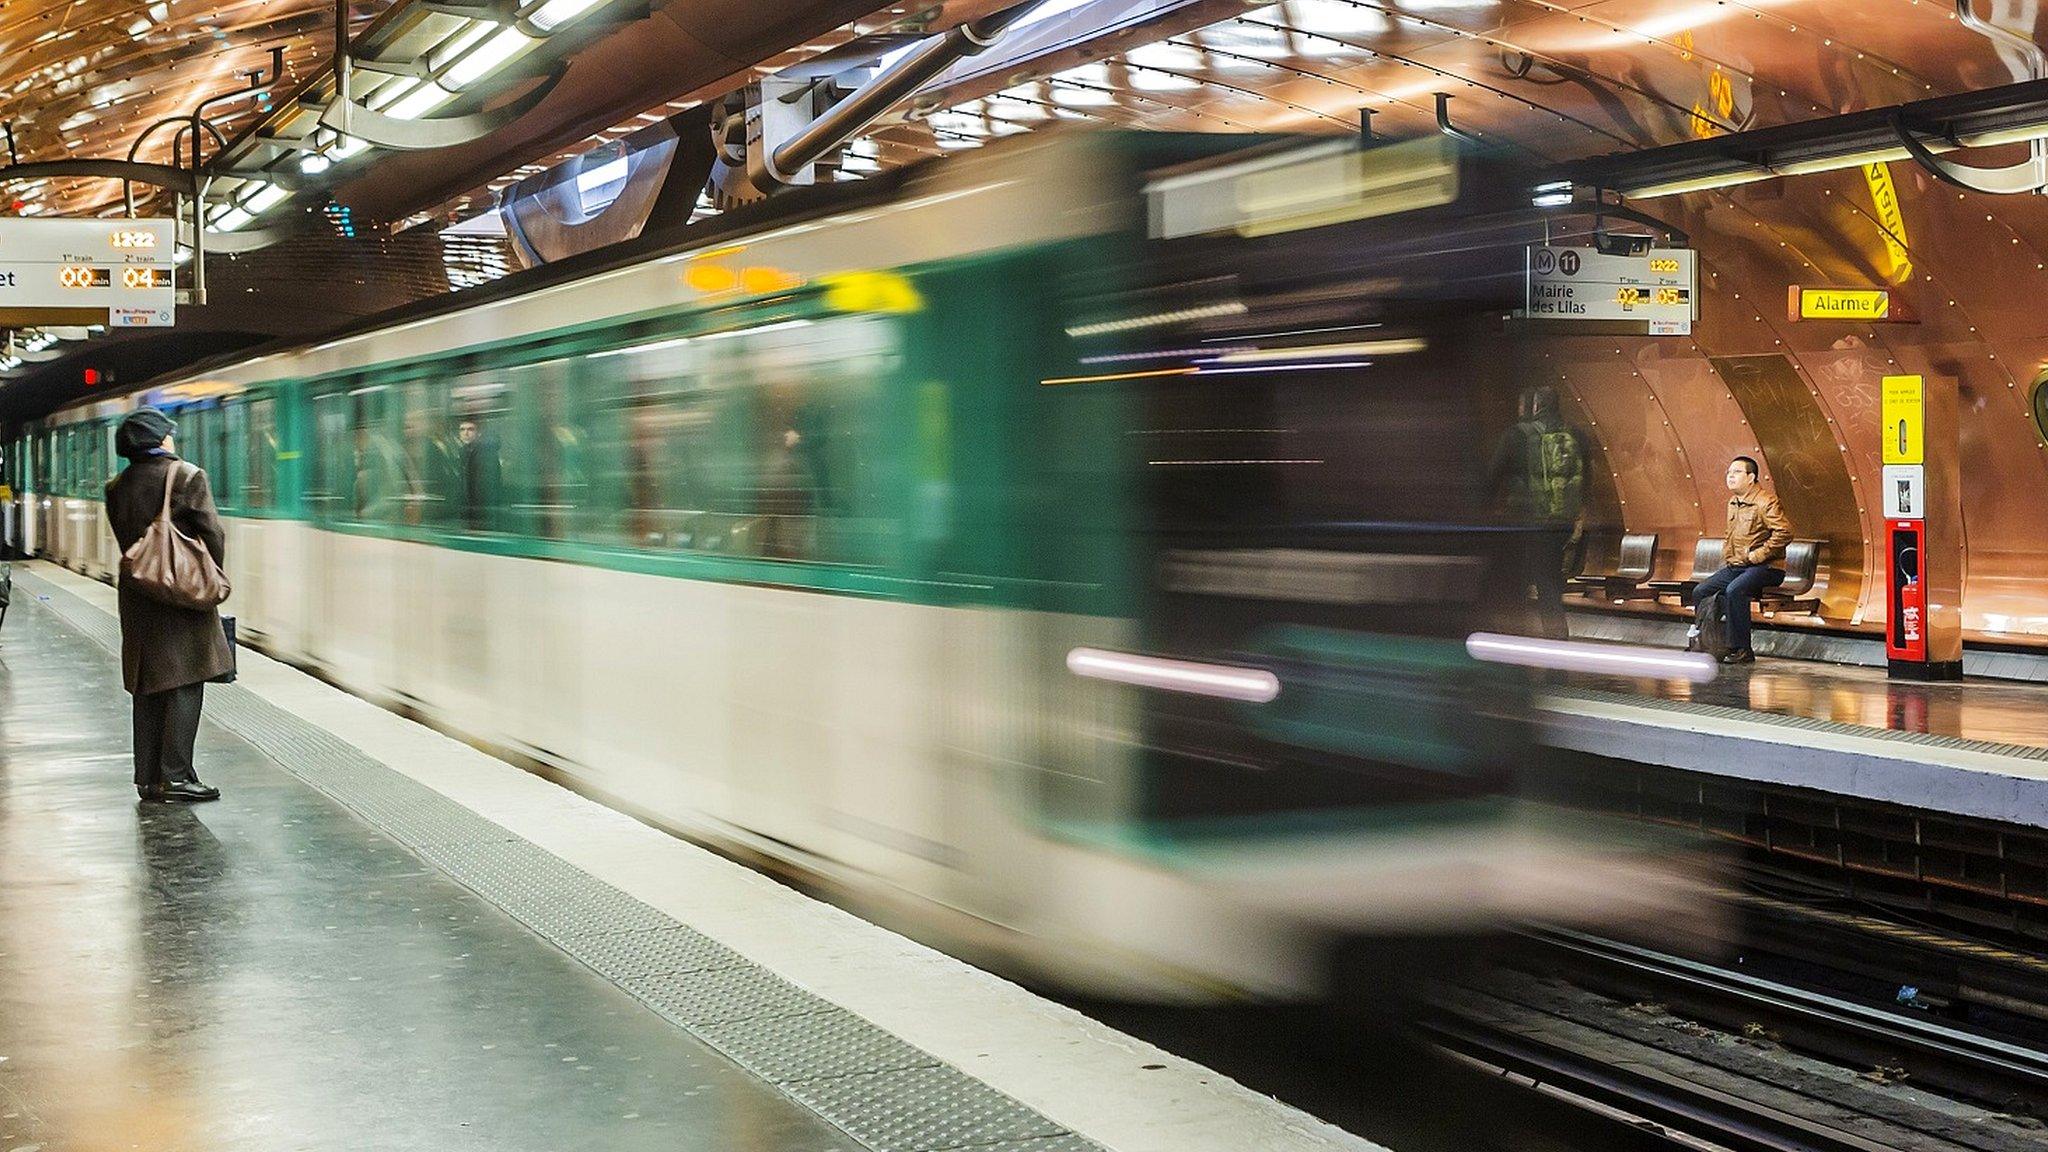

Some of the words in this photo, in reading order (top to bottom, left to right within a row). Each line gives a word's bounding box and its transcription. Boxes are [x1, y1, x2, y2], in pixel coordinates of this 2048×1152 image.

[1561, 254, 1577, 271] 11
[60, 267, 93, 288] 00
[123, 267, 153, 288] 04
[1533, 284, 1574, 298] Mairie
[1617, 287, 1640, 305] 02
[1657, 288, 1679, 305] 05
[1532, 300, 1554, 313] des
[1558, 300, 1587, 314] Lilas
[1814, 295, 1870, 311] Alarme
